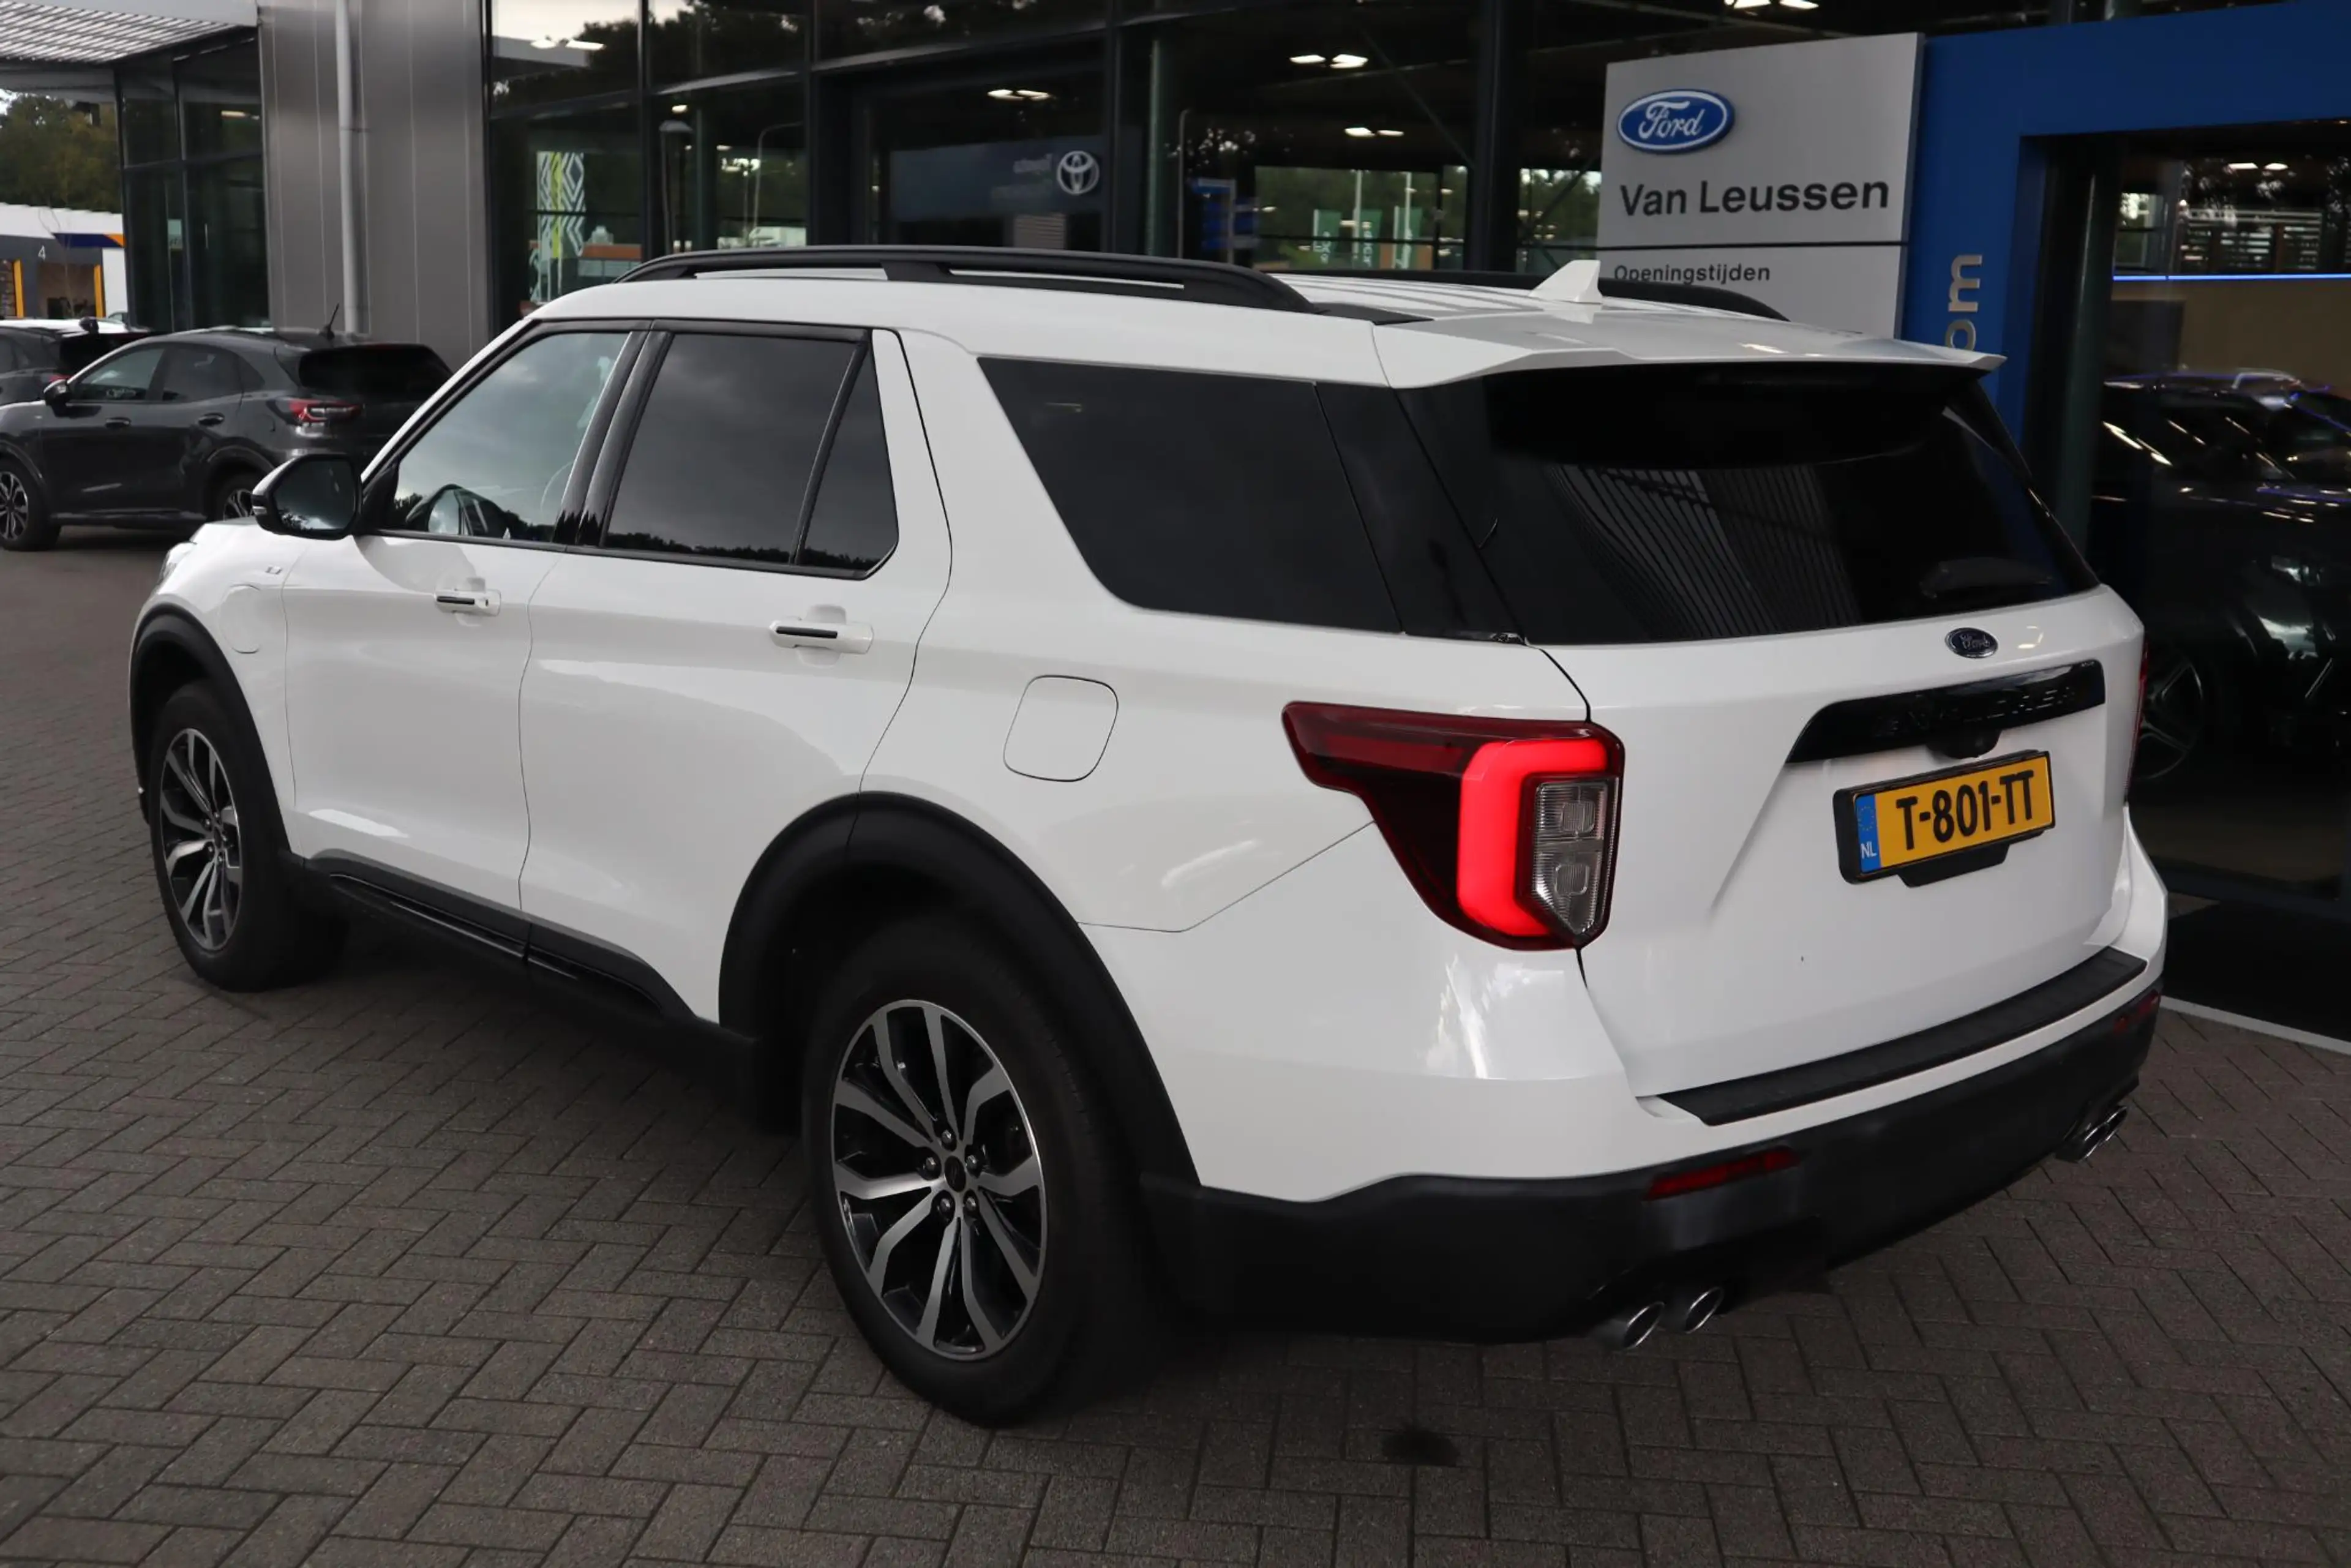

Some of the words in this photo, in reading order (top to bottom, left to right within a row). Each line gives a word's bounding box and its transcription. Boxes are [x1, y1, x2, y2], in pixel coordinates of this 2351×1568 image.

[1638, 100, 1706, 140] Ford
[1620, 184, 1687, 217] Van
[1700, 180, 1889, 213] Leussen
[38, 245, 46, 260] 4
[1614, 263, 1771, 285] Openingstijden
[1896, 769, 2034, 851] T-801-TT
[1861, 841, 1878, 860] NL
